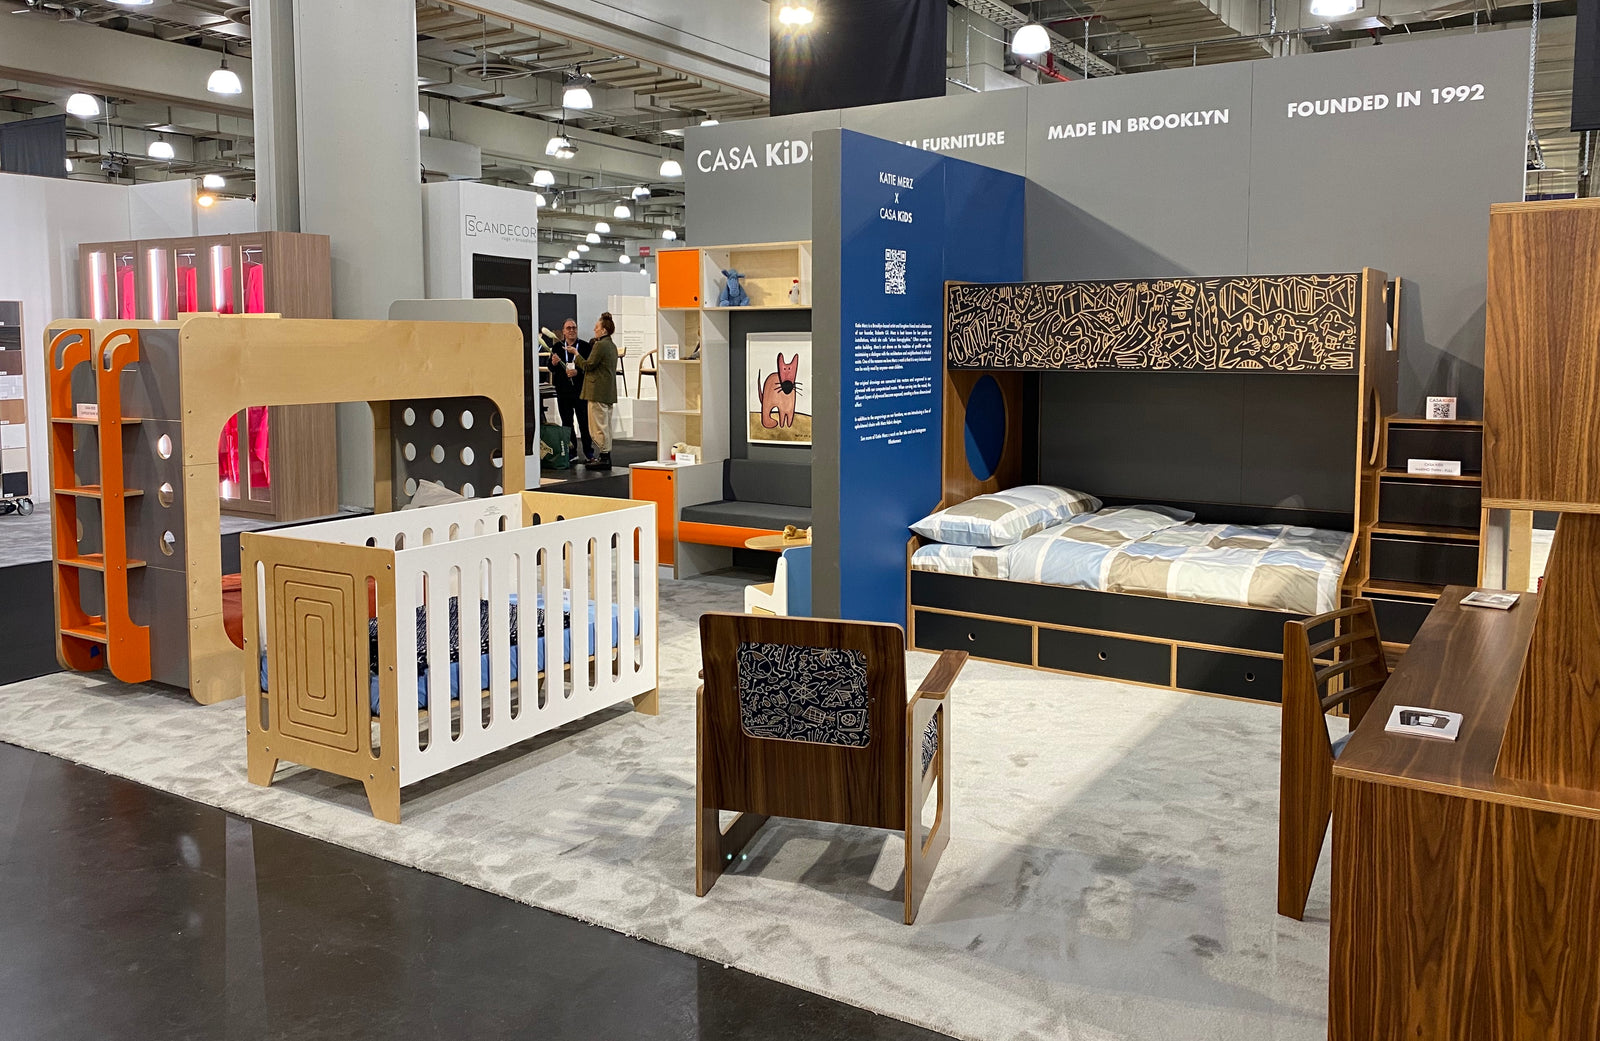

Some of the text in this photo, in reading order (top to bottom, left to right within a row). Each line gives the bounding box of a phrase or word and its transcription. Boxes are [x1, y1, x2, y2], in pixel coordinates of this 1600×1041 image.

[1287, 83, 1485, 118] FOUNDED IN 1992
[1047, 109, 1230, 140] MADE IN BROOKLYN
[922, 131, 1005, 151] FURNITURE
[697, 140, 813, 173] CASA KiD
[879, 171, 914, 190] KATIE MERZ
[894, 192, 900, 204] X
[879, 207, 897, 222] CASA
[467, 218, 536, 239] SCANDECOR
